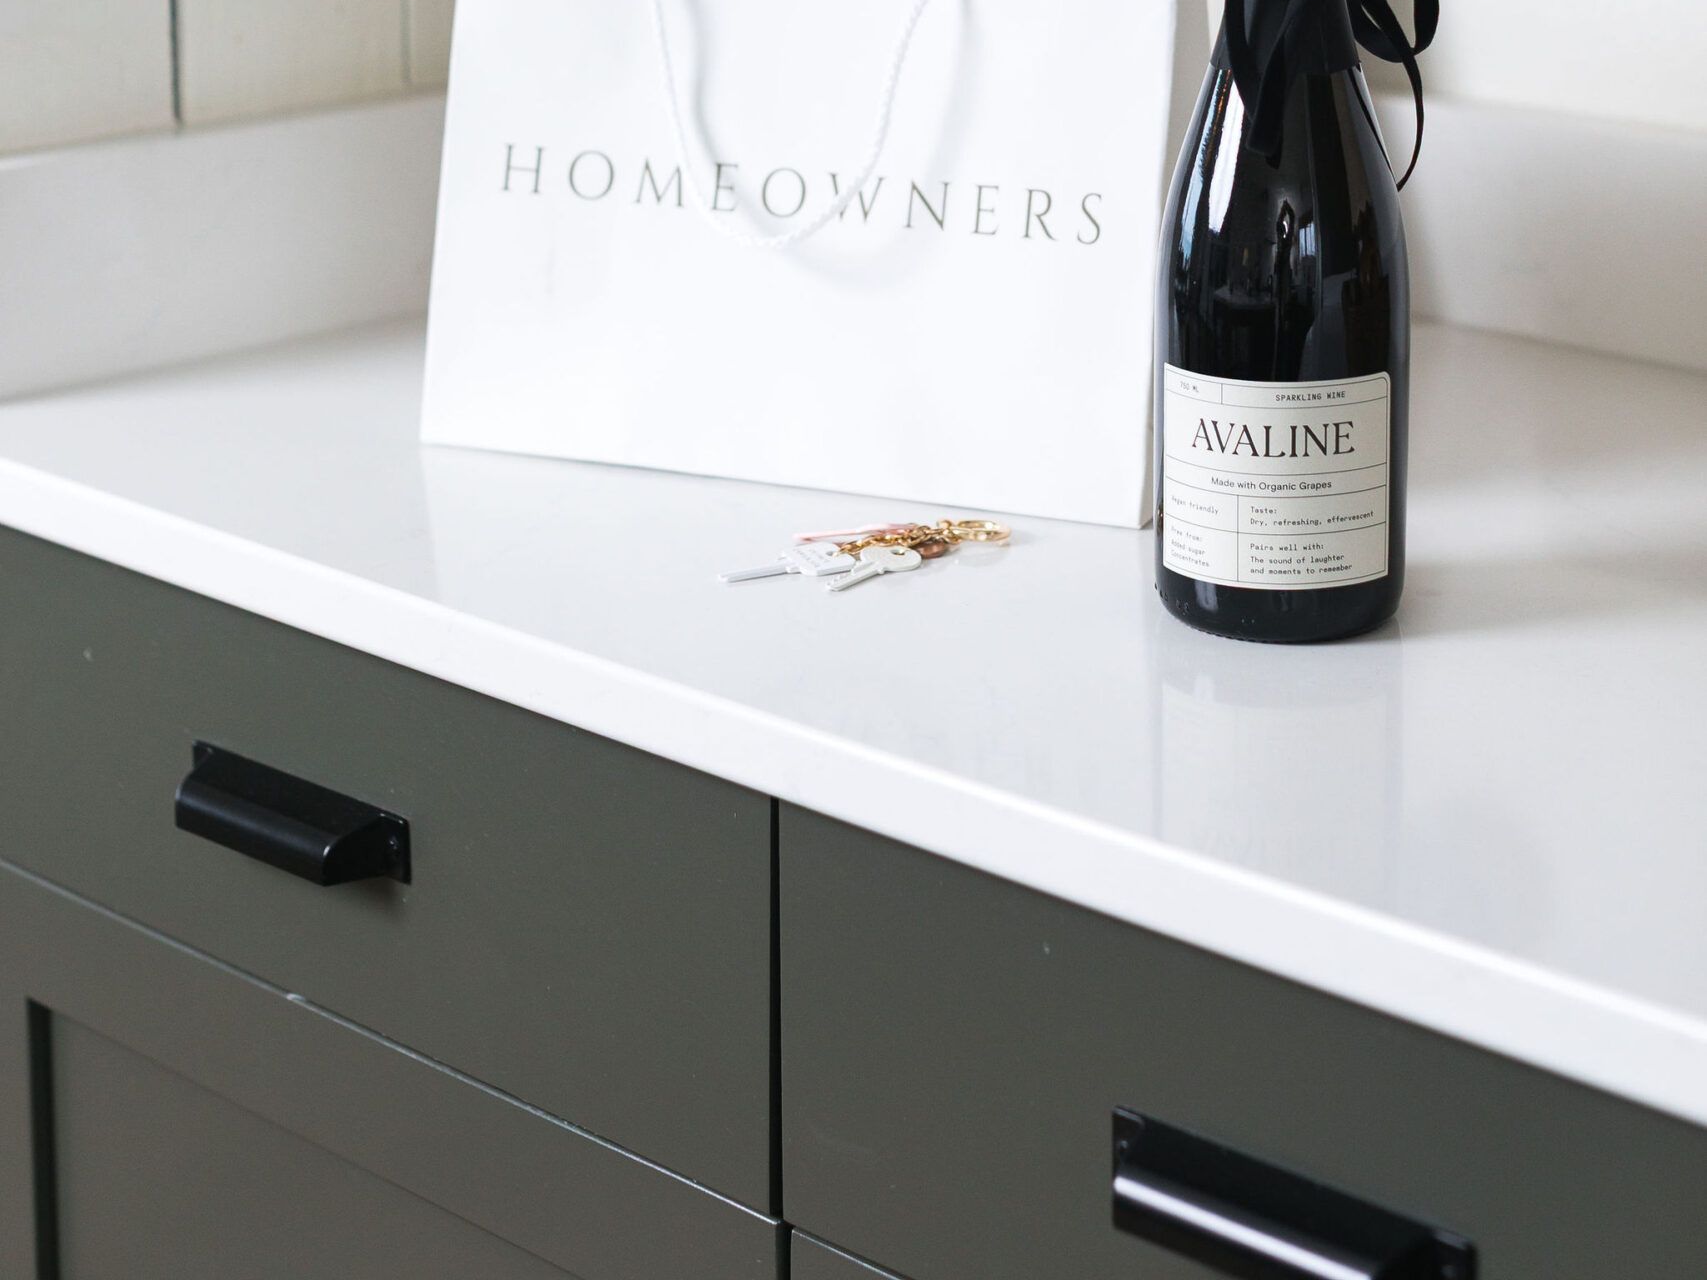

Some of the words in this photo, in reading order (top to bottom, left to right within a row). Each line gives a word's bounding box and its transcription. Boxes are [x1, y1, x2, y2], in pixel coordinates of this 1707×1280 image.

[1275, 393, 1323, 402] SPARKLING
[1326, 391, 1346, 399] WINE
[1192, 418, 1355, 458] AVALINE
[1211, 477, 1235, 488] Made
[1237, 479, 1256, 490] with
[1259, 482, 1296, 492] Organic
[1299, 480, 1332, 491] Grapes
[1189, 502, 1219, 515] friendly
[1251, 506, 1277, 514] Taste:
[1250, 519, 1268, 527] Dry,
[1273, 518, 1322, 527] refreshing,
[1327, 511, 1374, 523] effervescent
[1188, 545, 1206, 555] sugar
[1250, 543, 1274, 551] Pairs
[1279, 543, 1297, 551] well
[1303, 543, 1324, 551] with:
[1250, 556, 1264, 564] The
[1269, 556, 1292, 564] sound
[1296, 556, 1306, 564] of
[1311, 554, 1344, 564] laughter
[1269, 567, 1301, 575] moments
[1319, 563, 1352, 574] remember
